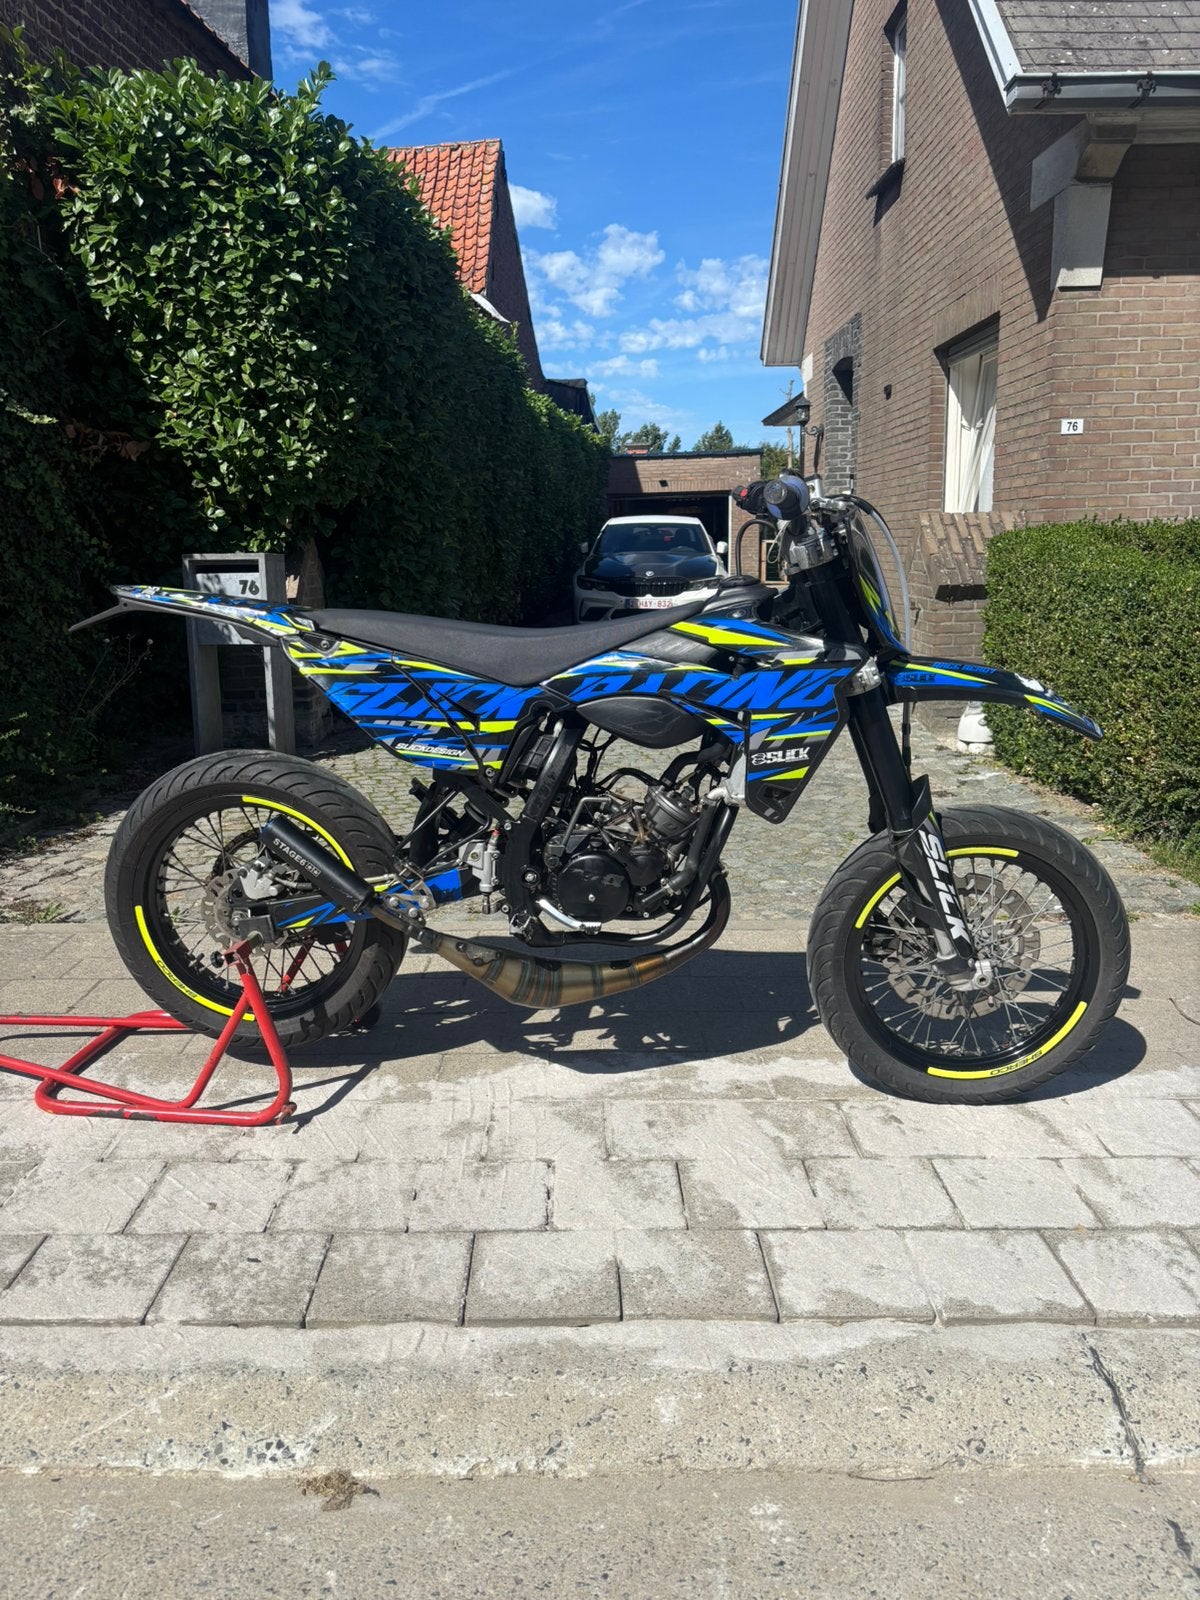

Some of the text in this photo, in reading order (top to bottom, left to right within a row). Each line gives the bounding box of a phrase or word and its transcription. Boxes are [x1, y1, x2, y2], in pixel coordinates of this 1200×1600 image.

[1067, 421, 1078, 431] 76
[239, 580, 260, 595] 76
[990, 1049, 1043, 1076] SHERCO
